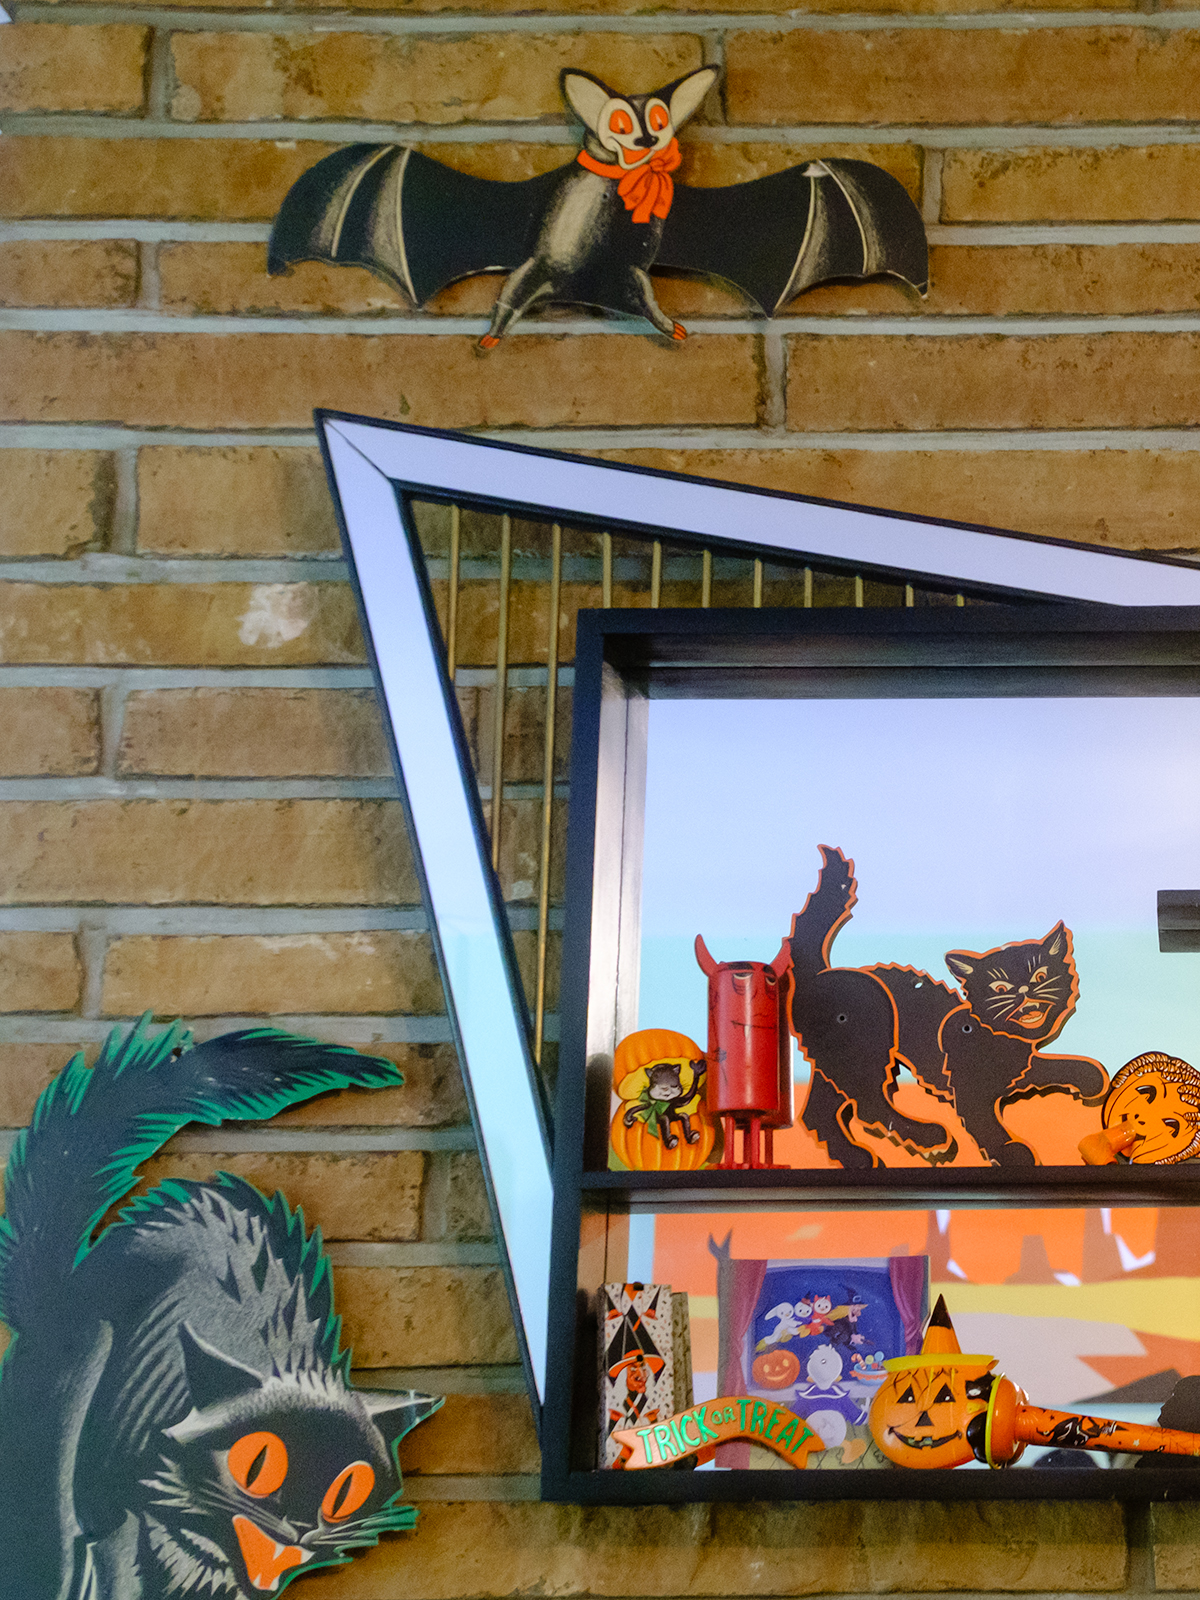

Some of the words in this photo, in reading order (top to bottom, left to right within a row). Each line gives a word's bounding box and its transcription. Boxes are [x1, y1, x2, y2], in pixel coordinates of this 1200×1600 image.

[637, 1406, 719, 1464] TRICK
[711, 1406, 736, 1425] OR
[736, 1399, 814, 1454] TREAT
